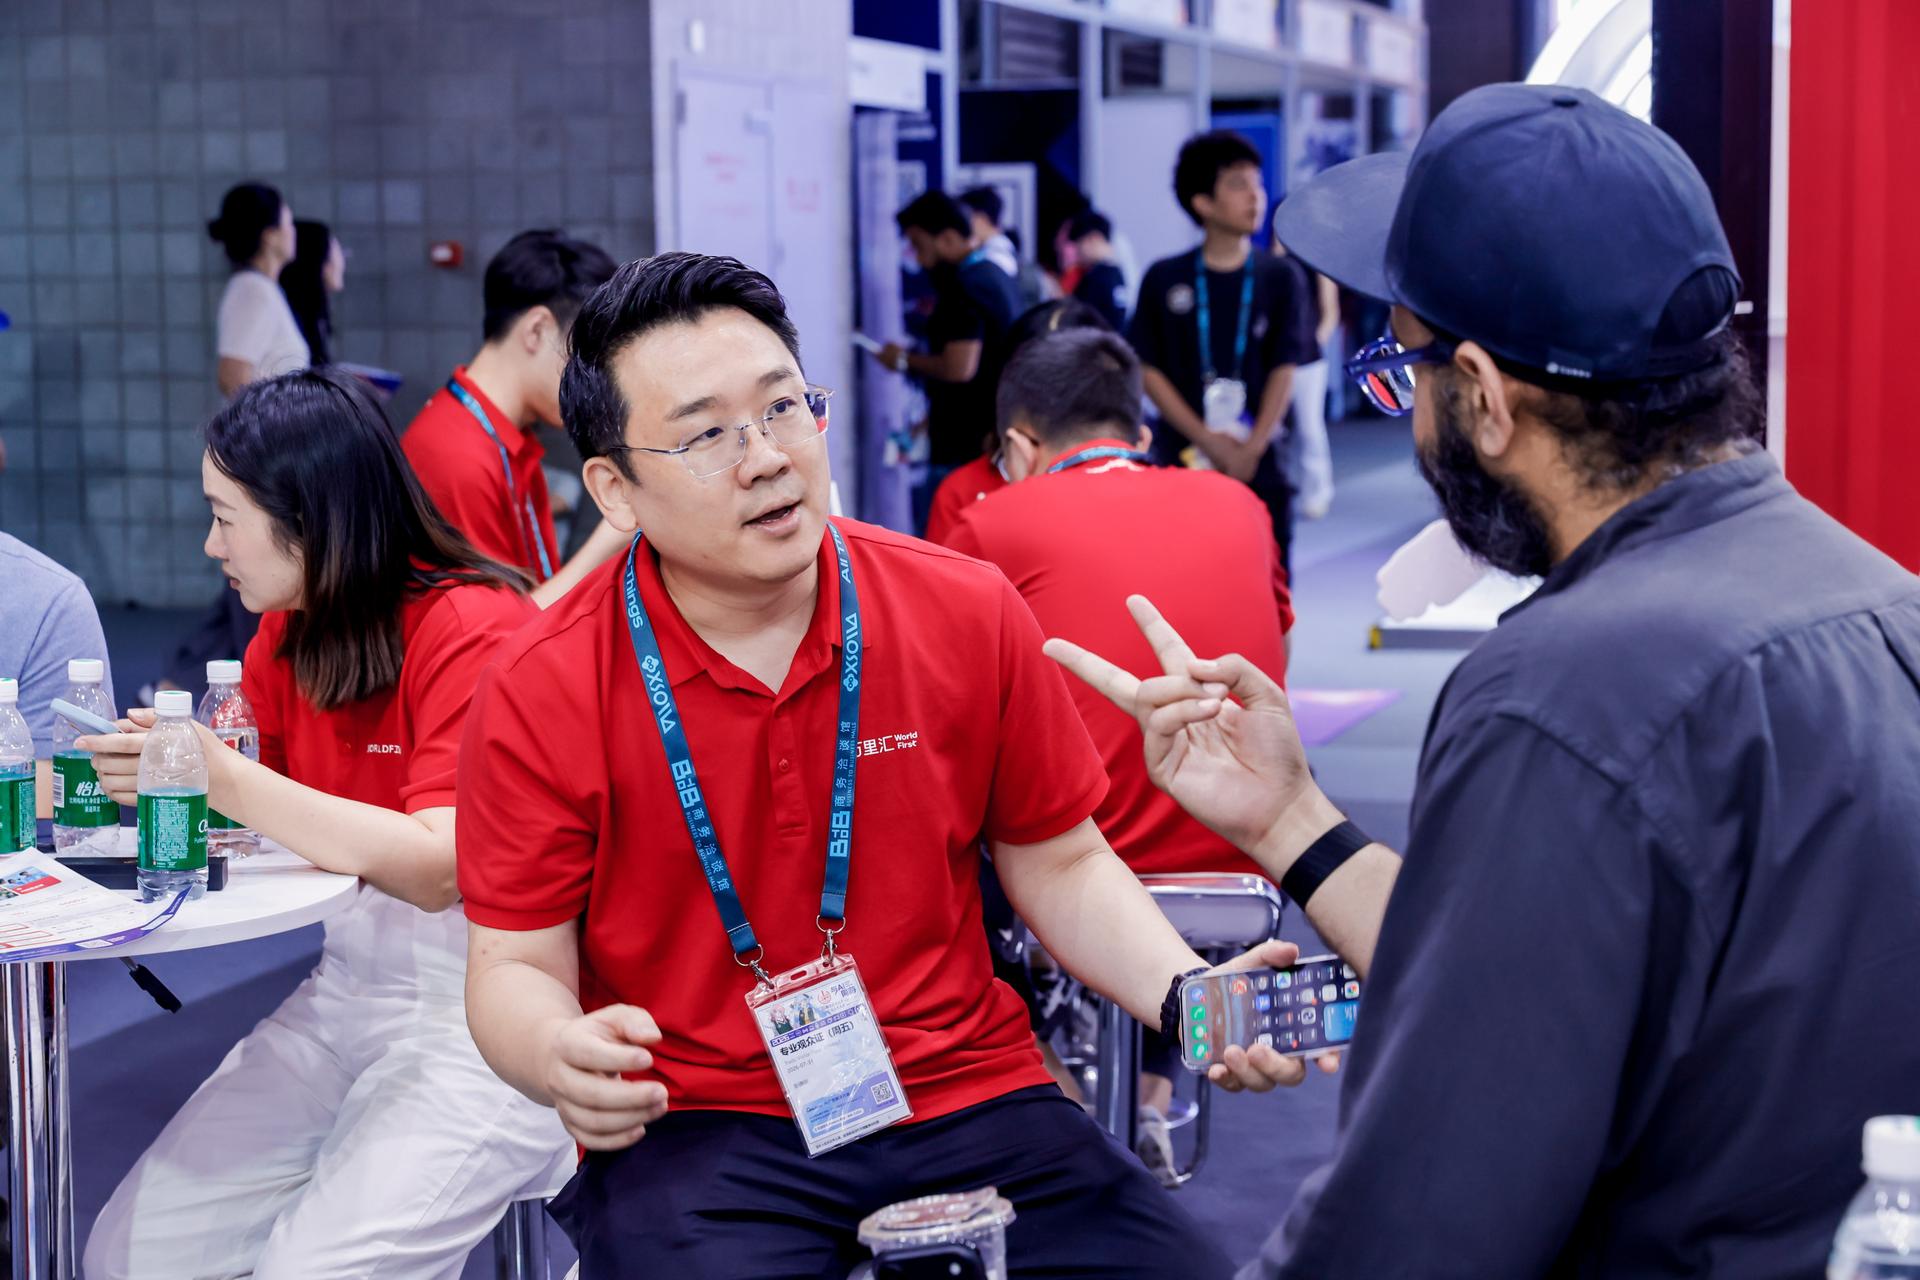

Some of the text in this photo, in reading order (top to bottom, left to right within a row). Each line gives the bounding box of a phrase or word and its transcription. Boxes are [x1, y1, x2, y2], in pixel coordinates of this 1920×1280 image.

[840, 557, 851, 584] All
[626, 565, 643, 629] Things
[894, 731, 918, 741] World
[897, 740, 917, 749] First
[835, 721, 850, 807] 商务洽谈馆
[692, 808, 730, 891] 商务洽谈馆
